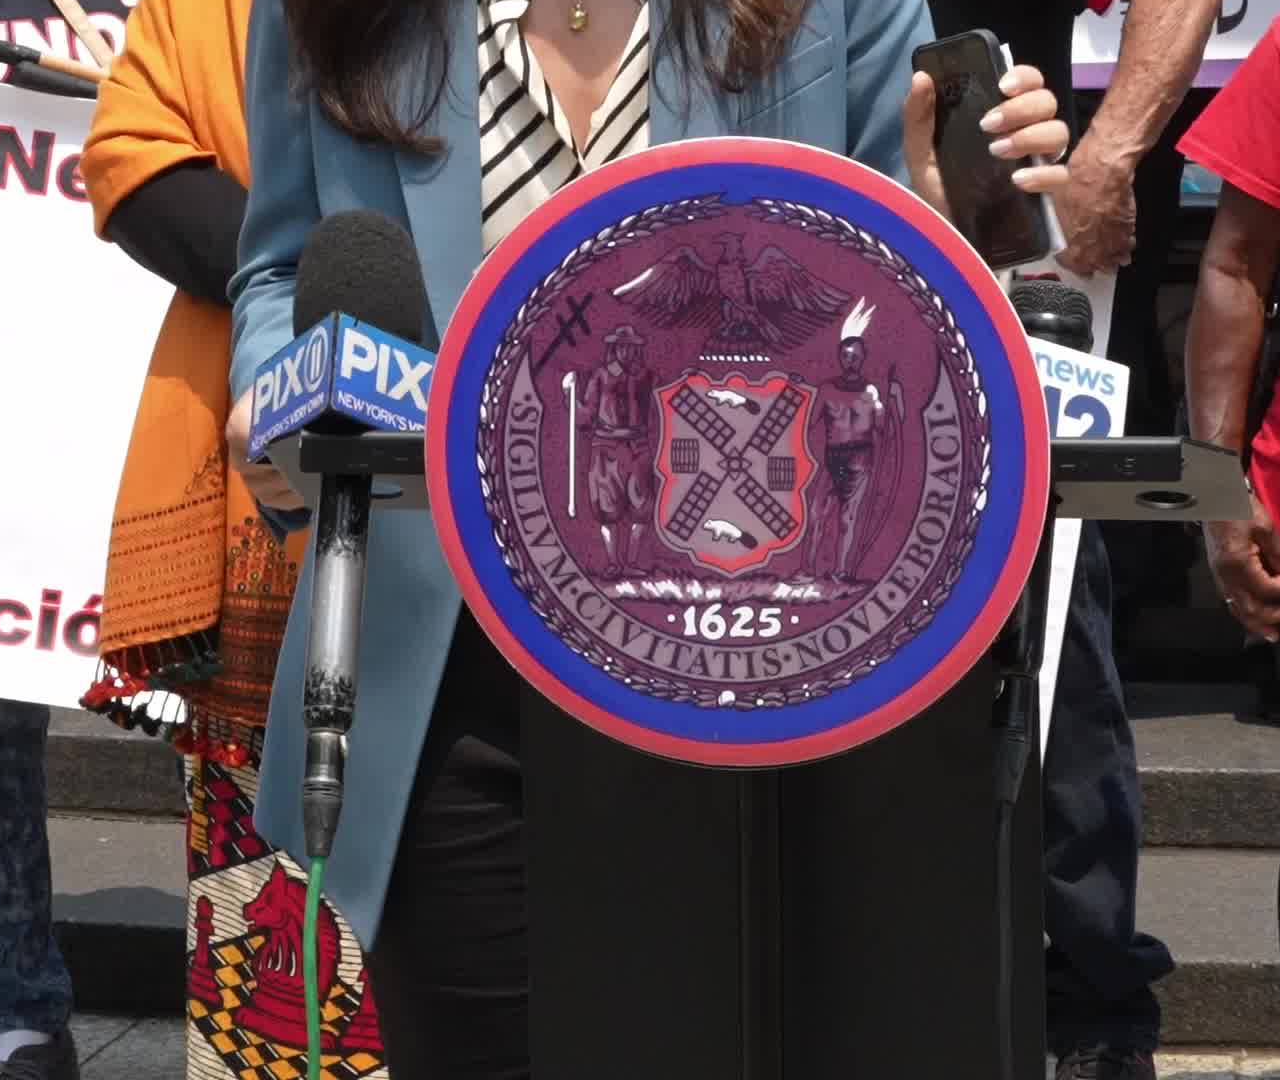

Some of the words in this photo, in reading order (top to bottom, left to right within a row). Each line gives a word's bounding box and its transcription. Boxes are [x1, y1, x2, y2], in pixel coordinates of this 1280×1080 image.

[1036, 352, 1115, 396] news
[337, 390, 365, 412] NEW
[365, 403, 407, 431] YORK'S
[1044, 384, 1112, 439] 12
[683, 603, 782, 640] 1625
